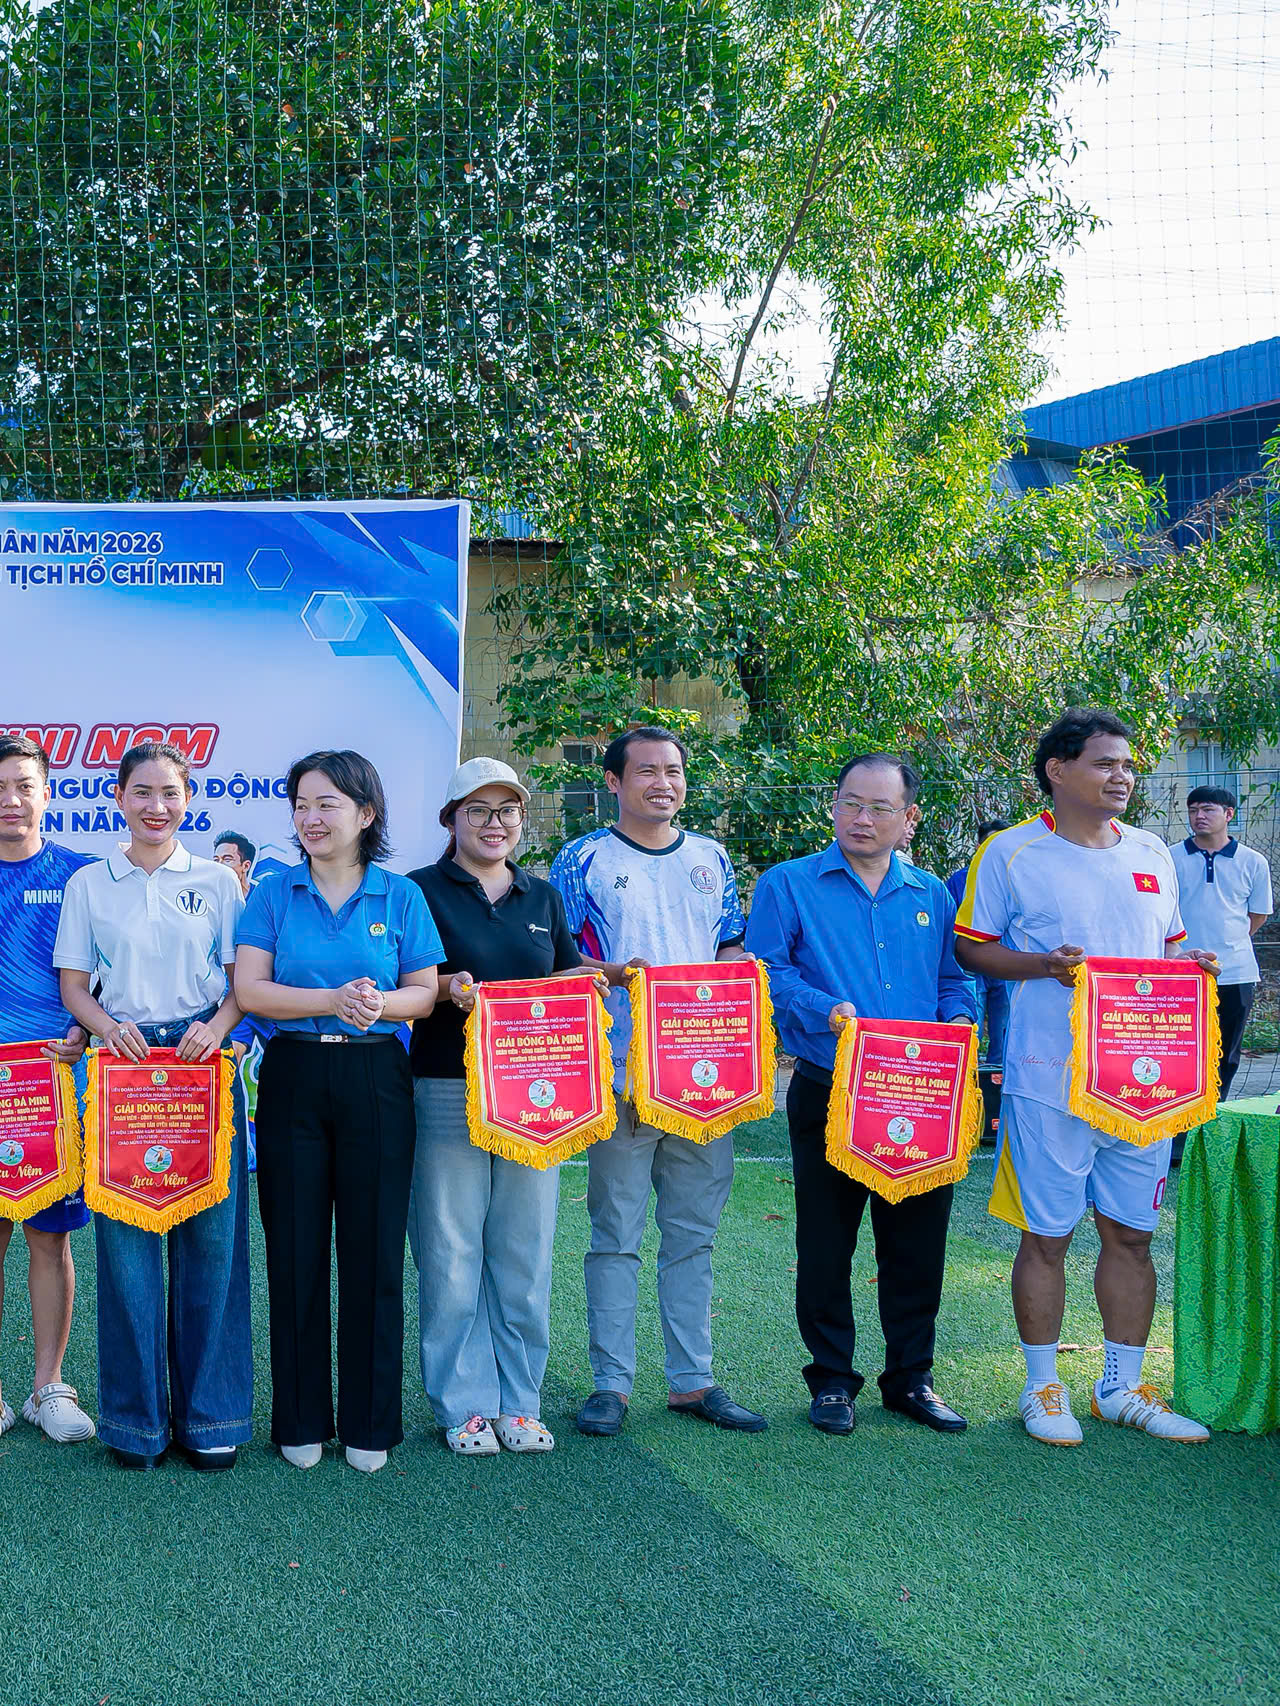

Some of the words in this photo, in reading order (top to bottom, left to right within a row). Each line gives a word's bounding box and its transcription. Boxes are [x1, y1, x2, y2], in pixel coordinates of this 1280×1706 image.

[43, 529, 98, 554] NĂM
[103, 532, 163, 554] 2026
[6, 564, 63, 591] TỊCH
[69, 556, 107, 584] HỒ
[111, 558, 155, 584] CHÍ
[159, 562, 223, 584] MINH
[205, 772, 288, 805] ĐỘNG
[24, 890, 62, 904] MINH
[661, 1017, 681, 1029] GIẢI
[683, 1017, 710, 1028] BÓNG
[711, 1016, 724, 1027] ĐÁ
[726, 1017, 748, 1027] MINI
[1102, 1010, 1121, 1023] GIẢI
[1123, 1012, 1150, 1024] BÓNG
[1152, 1012, 1166, 1024] ĐÁ
[1168, 1014, 1192, 1024] MINI
[495, 1035, 515, 1048] GIẢI
[517, 1034, 545, 1047] BÓNG
[546, 1034, 560, 1045] ĐÁ
[561, 1034, 583, 1044] MINI
[864, 1069, 885, 1083] GIẢI
[887, 1072, 913, 1085] BÓNG
[915, 1074, 927, 1087] ĐÁ
[928, 1078, 951, 1089] MINI
[14, 1095, 27, 1107] ĐÁ
[28, 1095, 50, 1105] MINI
[114, 1102, 135, 1114] GIẢI
[136, 1102, 165, 1113] BÓNG
[167, 1102, 180, 1113] ĐÁ
[182, 1103, 205, 1113] MINI
